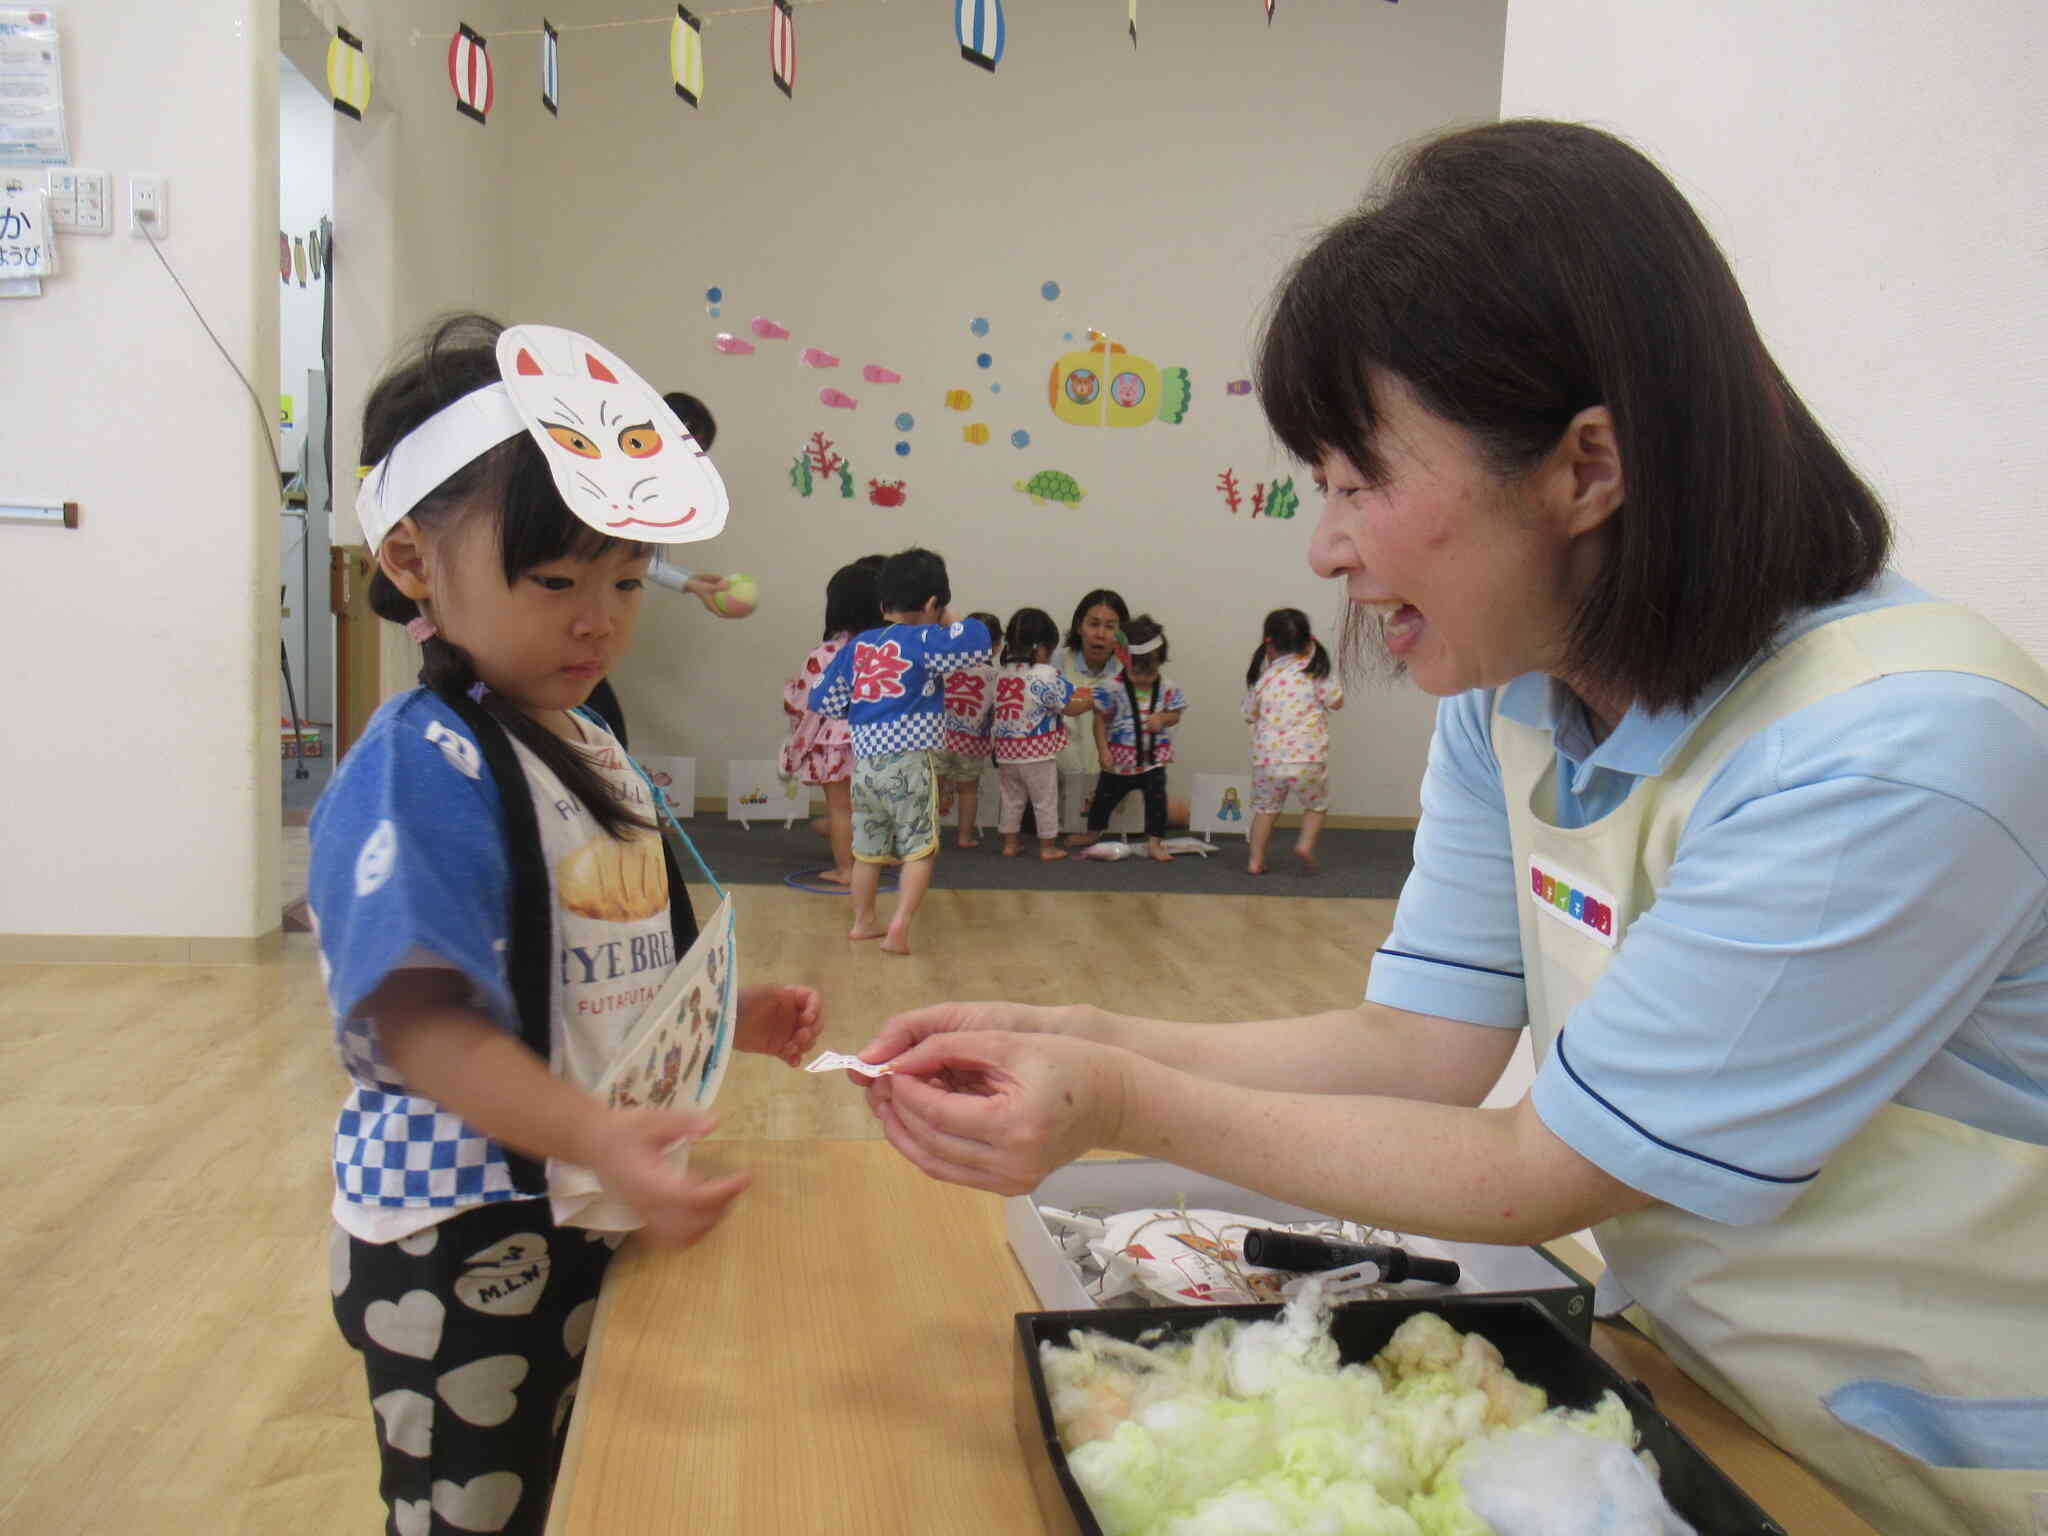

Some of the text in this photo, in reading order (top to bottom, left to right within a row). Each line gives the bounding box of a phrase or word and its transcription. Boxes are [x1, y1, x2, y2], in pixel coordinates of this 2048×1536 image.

[0, 207, 31, 240] か
[852, 641, 912, 702] 祭
[944, 671, 985, 717] 祭
[996, 676, 1026, 720] 祭
